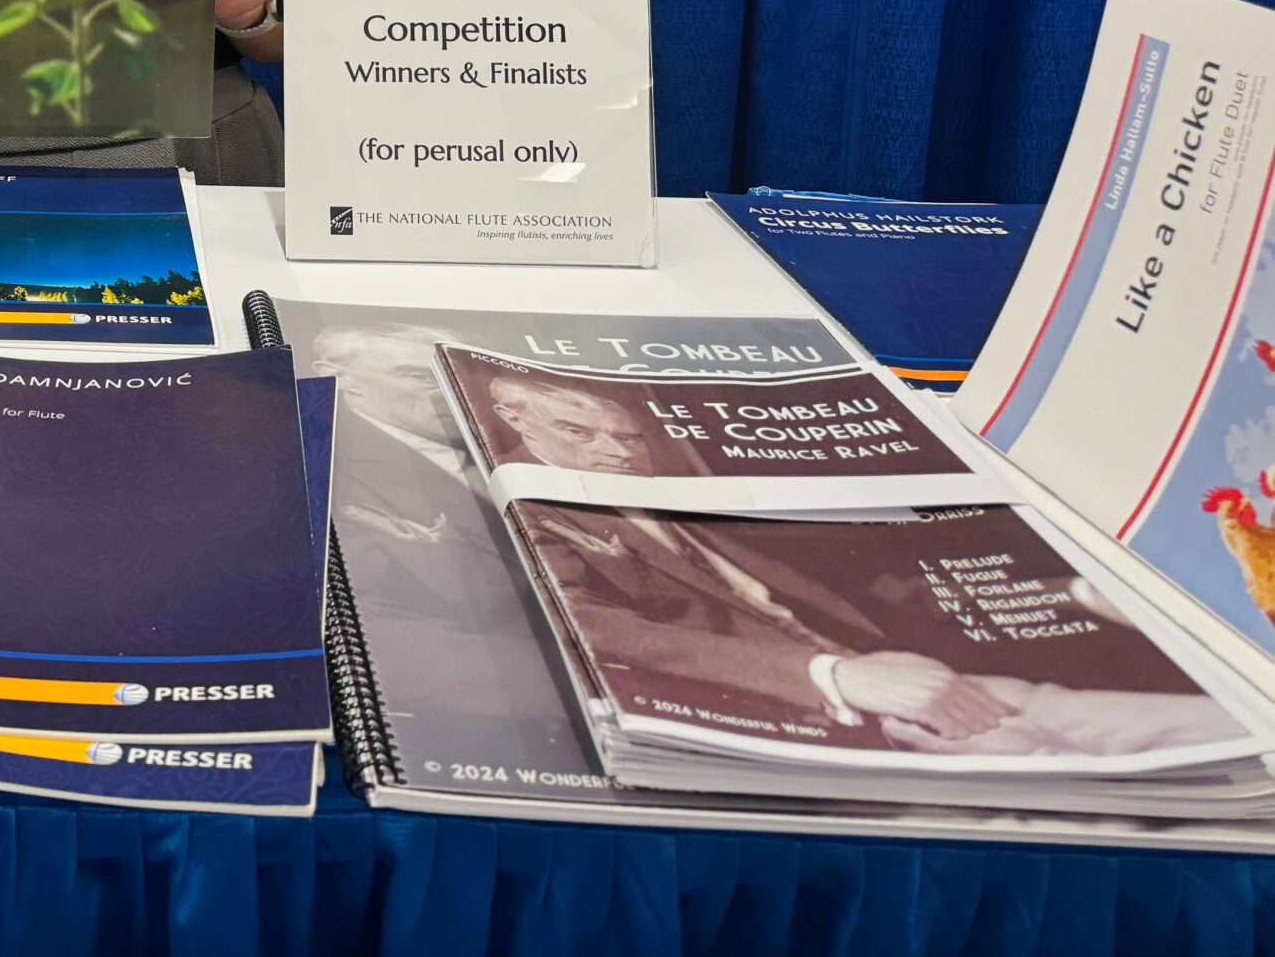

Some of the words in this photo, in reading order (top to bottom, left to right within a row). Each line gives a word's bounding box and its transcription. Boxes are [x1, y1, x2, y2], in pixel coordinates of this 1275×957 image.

[363, 15, 567, 50] Competition
[345, 61, 451, 83] Winners
[459, 62, 488, 88] &
[490, 62, 587, 85] Finalists
[1160, 60, 1222, 212] Chicken
[1199, 184, 1219, 215] for
[1210, 125, 1234, 180] Flute
[1226, 70, 1250, 122] Duet
[358, 137, 404, 163] (for
[413, 139, 505, 167] perusal
[514, 140, 579, 164] only)
[1104, 165, 1129, 211] Linda
[357, 212, 383, 224] THE
[389, 212, 462, 225] NATIONAL
[467, 213, 508, 226] FLUTE
[513, 214, 612, 228] ASSOCIATION
[748, 207, 870, 221] ADOLPHUS
[875, 213, 1005, 224] HAILSTORK
[758, 216, 847, 231] Circus
[851, 220, 1010, 236] Butterflies
[477, 230, 515, 240] Inspiring
[517, 230, 549, 240] flutists,
[551, 231, 592, 241] enriching
[594, 232, 614, 241] lives
[815, 230, 852, 238] Flutes
[1155, 223, 1177, 247] a
[1115, 255, 1165, 334] Like
[96, 314, 173, 324] PRESSER
[524, 334, 582, 356] LE
[597, 337, 822, 364] TOMBEAU
[470, 352, 530, 374] PICCOLO
[2, 407, 24, 417] for
[28, 410, 66, 420] Flute
[647, 401, 693, 419] LE
[703, 398, 880, 421] TOMBEAU
[664, 423, 711, 441] DE
[724, 418, 903, 442] COUPERIN
[721, 443, 828, 461] MAURICE
[838, 440, 920, 459] RAVEL
[919, 559, 934, 572] I.
[939, 553, 1015, 571] PRELUDE
[925, 573, 945, 585] II.
[952, 569, 1009, 584] FUGUE
[931, 586, 959, 600] III.
[965, 579, 1046, 599] FORLANE
[978, 592, 1072, 612] RIGAUDON
[989, 609, 1058, 627] MENUET
[963, 627, 998, 643] VI.
[1003, 620, 1100, 641] TOCCATA
[154, 684, 275, 702] PRESSER
[651, 698, 693, 717] 2024
[695, 708, 778, 733] WONDERFUL
[782, 720, 829, 738] WINDS
[127, 747, 253, 770] PRESSER
[451, 763, 508, 782] 2024
